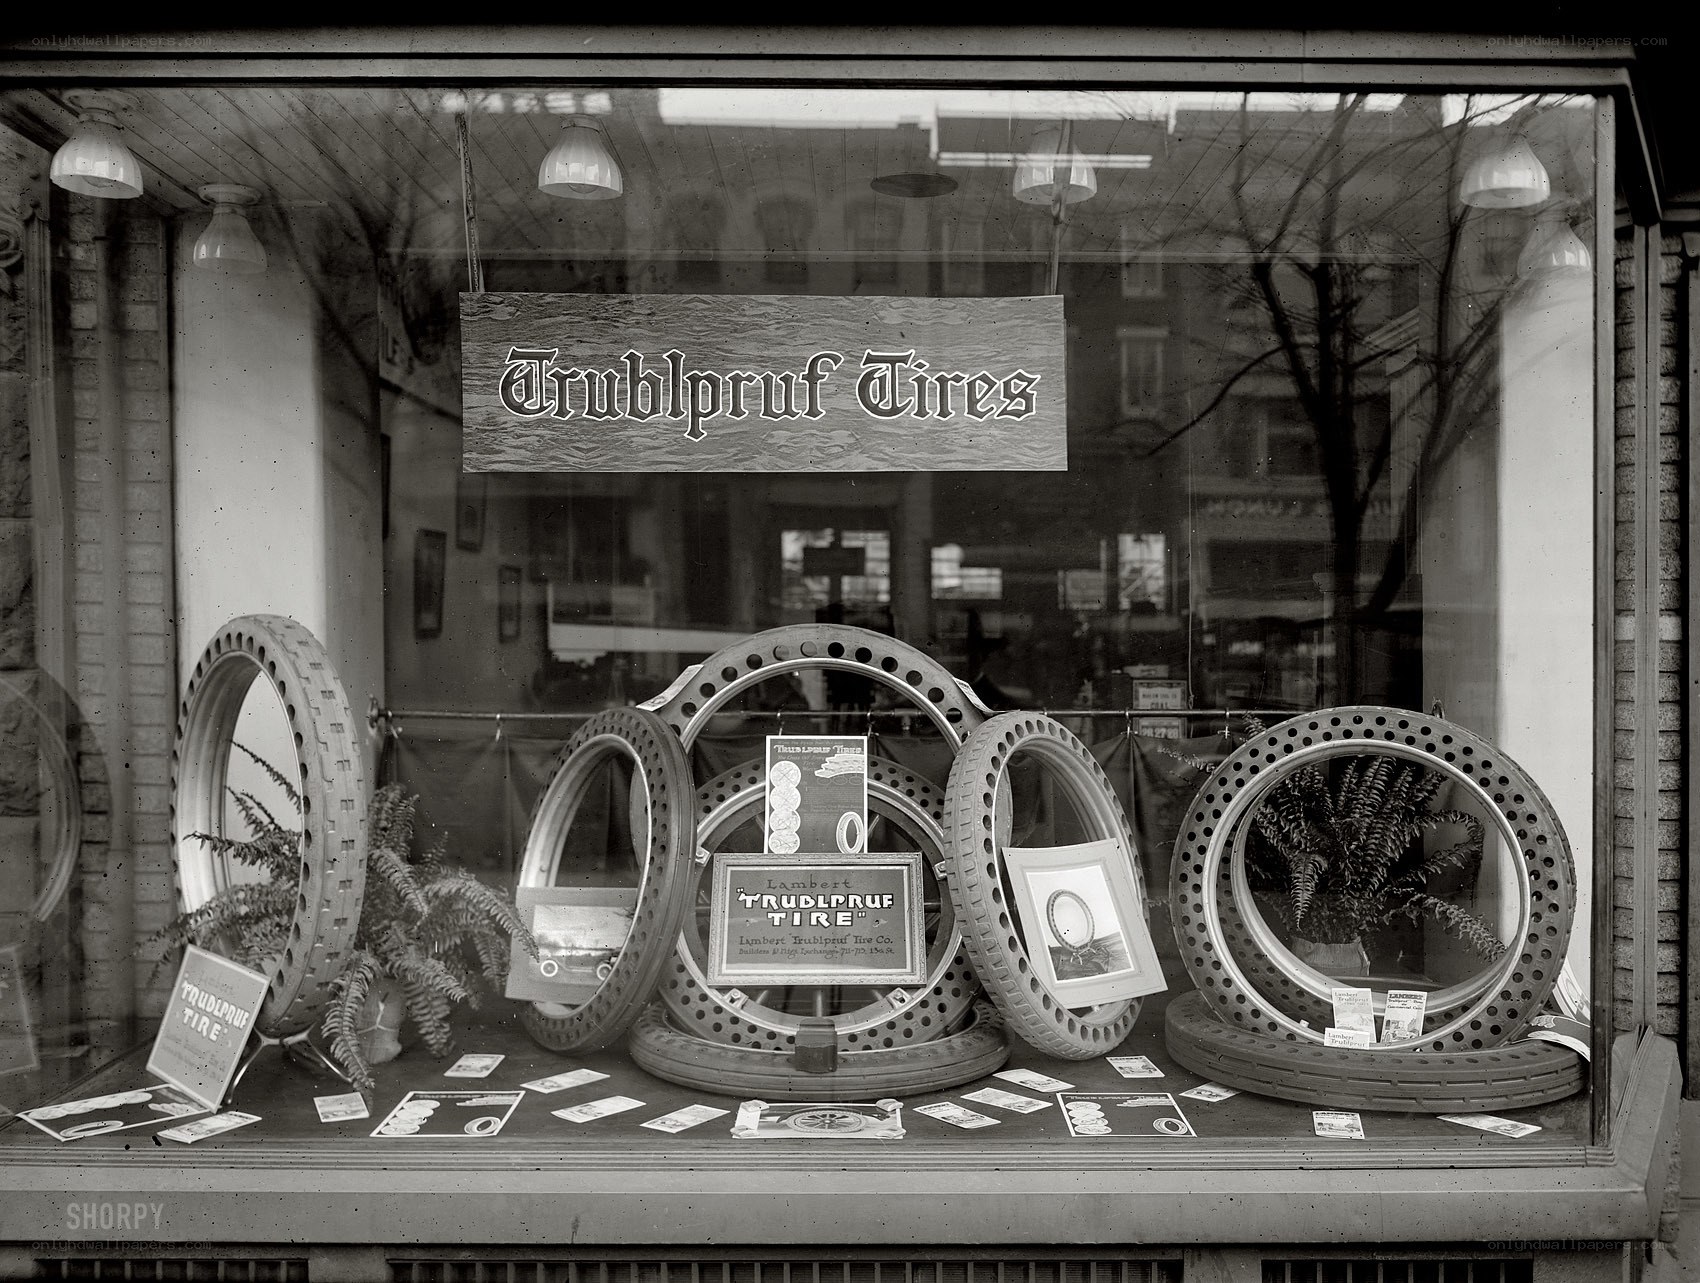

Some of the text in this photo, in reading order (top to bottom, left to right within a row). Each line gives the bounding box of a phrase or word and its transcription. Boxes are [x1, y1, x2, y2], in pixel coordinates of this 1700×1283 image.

[499, 345, 1041, 442] Trublpruf Tires
[766, 873, 853, 892] Lambert
[739, 935, 786, 947] Lambert
[853, 934, 873, 945] Tire
[875, 935, 894, 945] Co.
